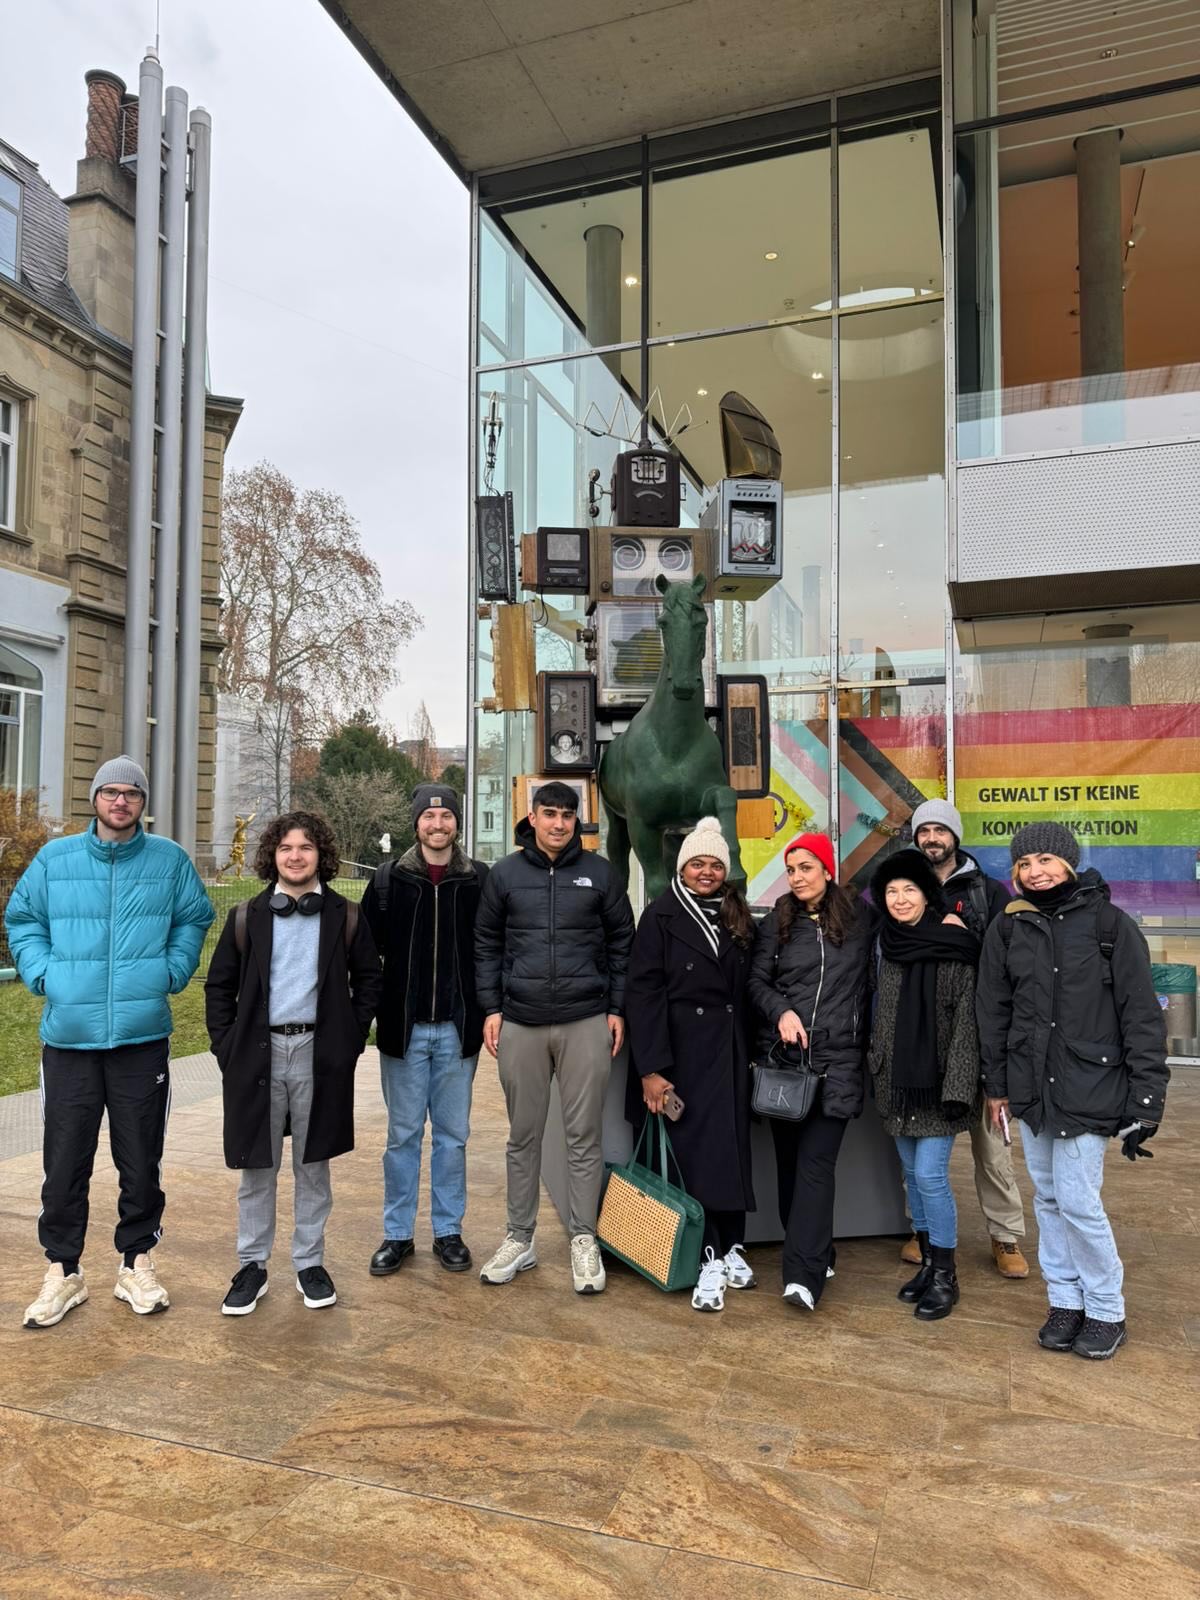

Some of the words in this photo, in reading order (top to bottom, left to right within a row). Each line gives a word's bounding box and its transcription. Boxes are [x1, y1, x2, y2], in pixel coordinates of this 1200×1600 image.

[978, 787, 1049, 803] GEWALT
[1054, 786, 1081, 801] IST
[1086, 784, 1140, 801] KEINE
[982, 820, 1138, 836] KOMIKATION
